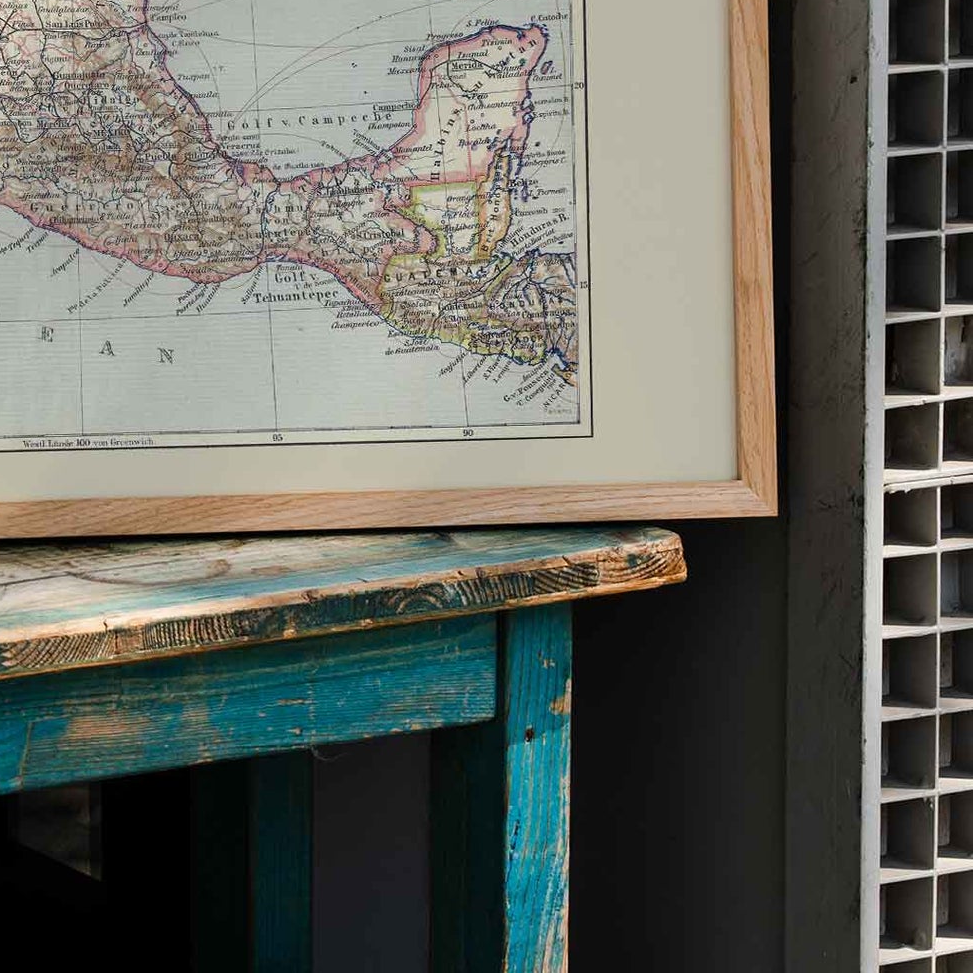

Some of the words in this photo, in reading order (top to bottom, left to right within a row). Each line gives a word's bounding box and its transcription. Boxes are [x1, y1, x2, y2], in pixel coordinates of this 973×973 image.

[574, 82, 584, 90] 20
[463, 429, 474, 437] 90
[273, 434, 283, 442] 95
